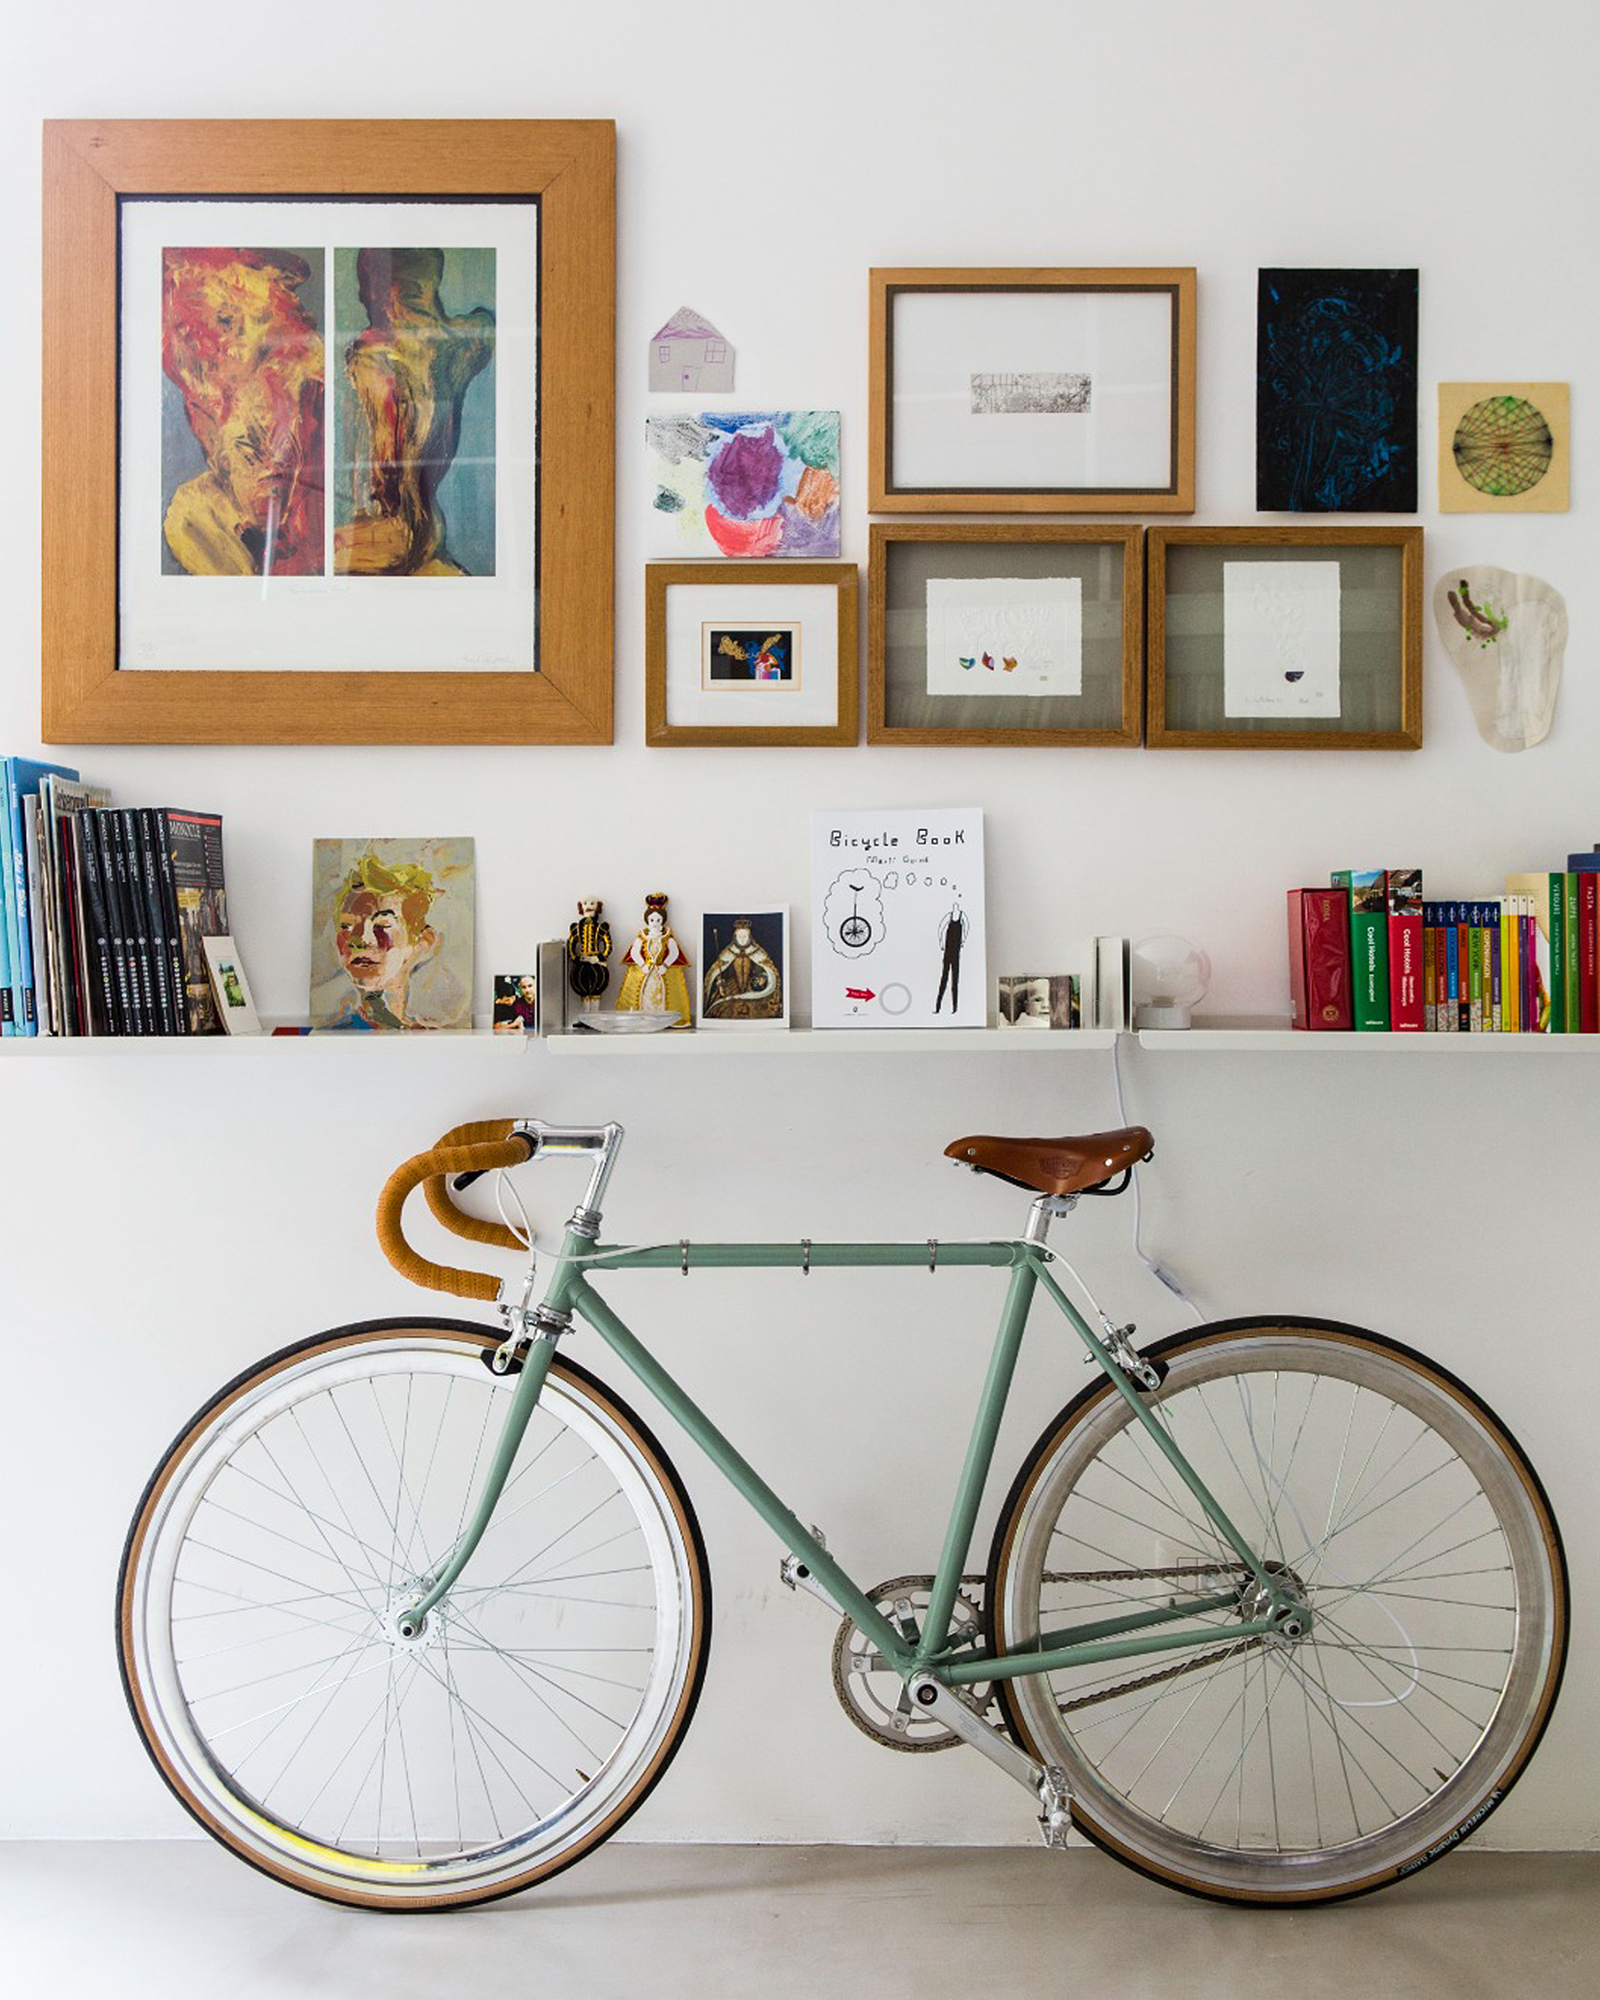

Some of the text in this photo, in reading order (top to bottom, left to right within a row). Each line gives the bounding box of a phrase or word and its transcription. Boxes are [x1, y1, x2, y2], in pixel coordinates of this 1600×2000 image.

[829, 830, 899, 851] Bicycle
[1586, 886, 1594, 910] PASTA
[1367, 926, 1375, 945] Cool
[1472, 930, 1480, 949] NEW
[1368, 946, 1376, 972] Hotels
[1403, 928, 1412, 974] Cool Hotels
[1472, 950, 1480, 970] YORK
[1483, 930, 1491, 978] COPENHAGEN
[1460, 1799, 1495, 1834] MICHELIN
